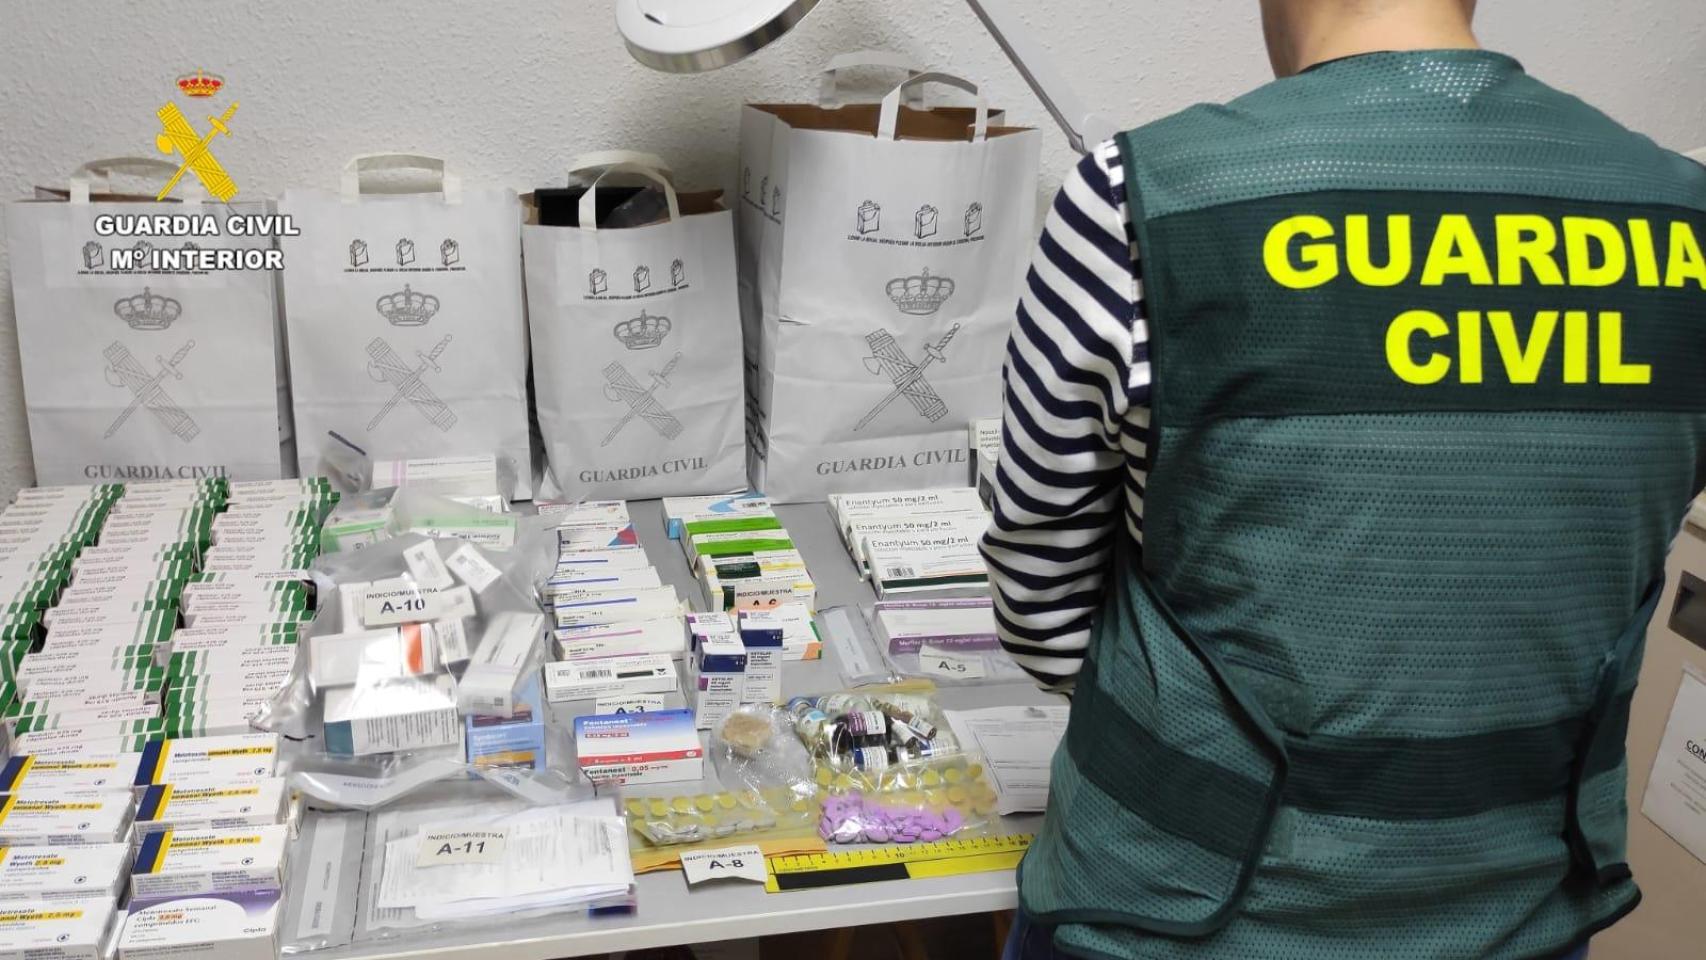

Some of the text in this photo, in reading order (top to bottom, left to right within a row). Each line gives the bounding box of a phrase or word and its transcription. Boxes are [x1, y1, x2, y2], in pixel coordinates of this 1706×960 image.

[1263, 214, 1706, 290] GUARDIA
[1385, 309, 1652, 385] CIVIL
[816, 448, 967, 476] GUARDIA CIVIL
[84, 464, 232, 480] GUARDIA CIVIL
[579, 456, 708, 484] GUARDIA CIVIL
[846, 498, 890, 506] Enantyum
[856, 523, 902, 532] Enantyum
[872, 539, 919, 549] Enantyum
[957, 535, 969, 543] ml
[380, 599, 425, 614] A-10
[938, 660, 966, 673] A-5
[436, 841, 487, 856] A-11
[709, 859, 744, 870] A-8
